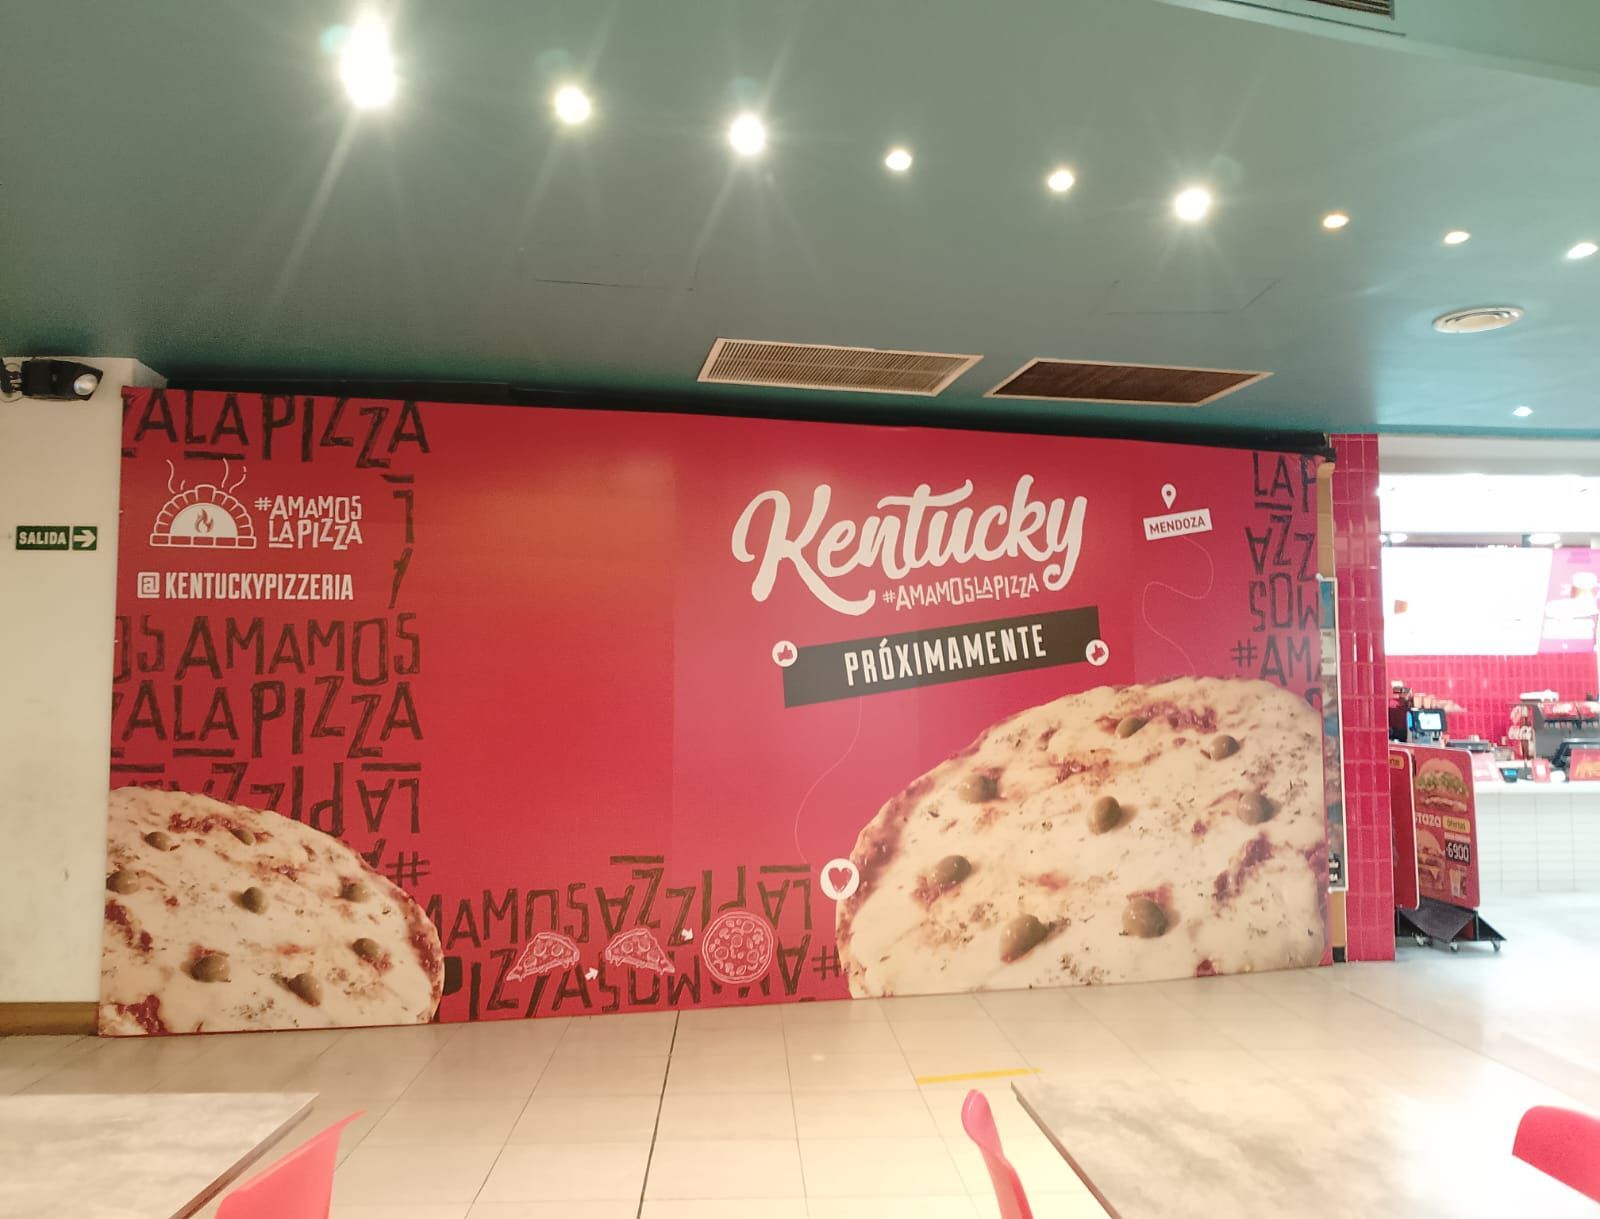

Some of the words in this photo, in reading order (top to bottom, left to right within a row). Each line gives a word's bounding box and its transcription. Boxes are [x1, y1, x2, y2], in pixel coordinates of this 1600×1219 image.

[254, 495, 363, 525] #AMAMOS
[1149, 515, 1206, 535] MENDOZA
[18, 532, 67, 546] SALIDA
[731, 474, 1087, 617] Kentucky
[882, 573, 1040, 612] #AMAMOSLAPIZZA
[174, 612, 421, 687] AMAMOS
[843, 623, 1047, 687] PRÓXIMAMENTE
